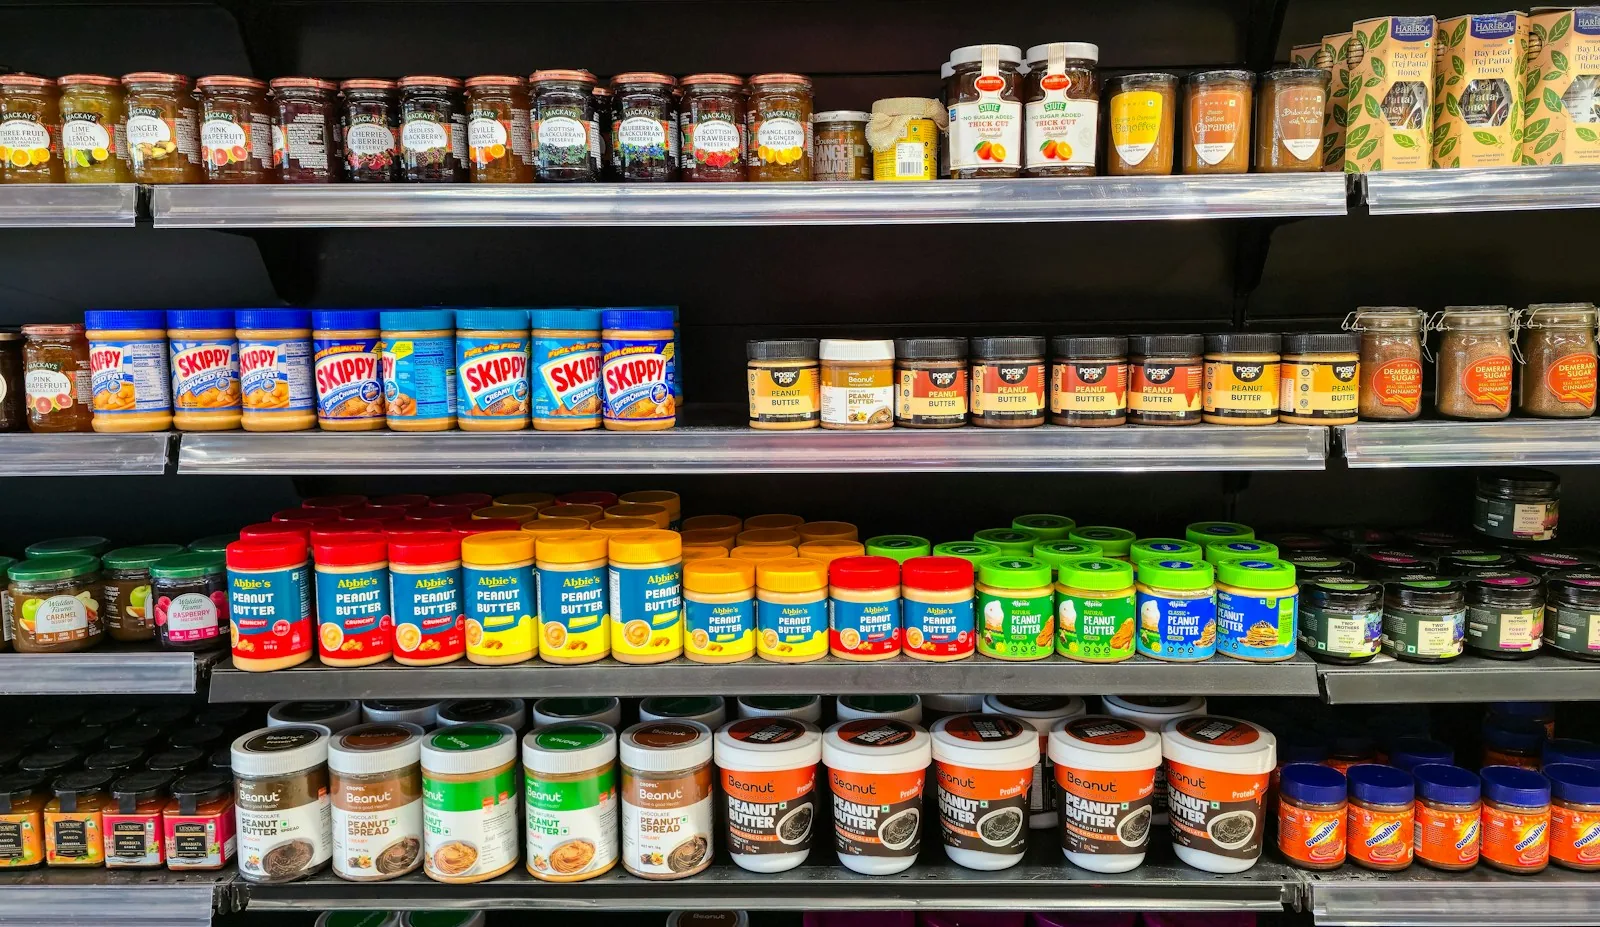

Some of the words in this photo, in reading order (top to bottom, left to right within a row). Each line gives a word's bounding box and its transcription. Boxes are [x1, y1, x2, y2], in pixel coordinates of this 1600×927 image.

[1394, 52, 1408, 60] Bay
[1410, 51, 1428, 59] Leaf
[1474, 49, 1489, 58] Bay
[1492, 48, 1512, 56] Leaf
[1391, 60, 1406, 68] (Tej
[1407, 60, 1429, 68] Patta)
[1471, 58, 1487, 66] (Tej
[1488, 57, 1513, 65] Patta)
[1397, 68, 1421, 77] Honey
[1478, 67, 1504, 75] Honey
[3, 112, 36, 121] MACKAYS
[66, 112, 96, 122] MACKAYS
[205, 112, 233, 121] MACKAYS
[406, 111, 435, 121] MACKAYS
[545, 109, 576, 118] MACKAYS
[625, 108, 655, 118] MACKAYS
[702, 111, 732, 121] MACKAYS
[766, 110, 796, 119] MACKAYS
[352, 116, 384, 125] MACKAYS
[129, 124, 158, 132] GINGER
[1195, 122, 1235, 133] Caramel
[620, 345, 657, 356] CRUNCHY
[28, 361, 58, 371] MACKAYS
[178, 350, 229, 378] SKIPPY
[1559, 363, 1595, 372] DEMERARA
[214, 370, 233, 380] FAT
[261, 371, 280, 380] FAT
[316, 357, 375, 394] SKIPPY
[466, 355, 526, 393] SKIPPY
[1384, 368, 1420, 376] DEMERARA
[1475, 366, 1511, 374] DEMERARA
[1567, 369, 1592, 377] SUGAR
[107, 372, 124, 382] FAT
[606, 358, 665, 395] SKIPPY
[778, 377, 793, 385] POP
[848, 375, 874, 384] Beanut
[1006, 373, 1020, 381] POP
[1150, 373, 1166, 381] POP
[1240, 372, 1256, 380] POP
[1391, 374, 1416, 382] SUGAR
[936, 378, 951, 386] POP
[1562, 383, 1594, 391] CINNAMON
[771, 389, 801, 397] PEANUT
[997, 386, 1029, 394] PEANUT
[1075, 385, 1107, 393] PEANUT
[1142, 385, 1176, 394] PEANUT
[1231, 384, 1263, 392] PEANUT
[1478, 385, 1508, 394] CINNAMON
[484, 386, 510, 405] CREAMY
[848, 392, 875, 400] PEANUT
[928, 390, 957, 398] PEANUT
[997, 395, 1027, 403] BUTTER
[1075, 394, 1105, 402] BUTTER
[1142, 395, 1173, 403] BUTTER
[1231, 393, 1262, 401] BUTTER
[771, 398, 800, 407] BUTTER
[337, 577, 378, 590] Abbie's
[415, 577, 454, 590] Abbie's
[478, 576, 518, 588] Abbie's
[562, 576, 601, 588] Abbie's
[646, 571, 680, 586] Abbie's
[233, 578, 271, 591] Abbie's
[335, 589, 380, 604] PEANUT
[413, 589, 457, 604] PEANUT
[476, 589, 521, 601] PEANUT
[561, 588, 602, 602] PEANUT
[645, 583, 681, 600] PEANUT
[232, 592, 274, 604] PEANUT
[335, 602, 382, 616] BUTTER
[413, 601, 457, 616] BUTTER
[476, 601, 521, 613] BUTTER
[560, 600, 603, 614] BUTTER
[644, 596, 682, 612] BUTTER
[172, 609, 211, 619] RASPBERRY
[232, 604, 275, 616] BUTTER
[712, 606, 739, 615] Abbie's
[781, 607, 808, 616] Abbie's
[863, 606, 889, 615] Abbie's
[926, 607, 953, 615] Abbie's
[46, 612, 77, 620] CARAMEL
[422, 616, 452, 626] CRUNCHY
[708, 614, 742, 625] PEANUT
[778, 615, 811, 626] PEANUT
[859, 613, 892, 624] PEANUT
[922, 615, 957, 625] PEANUT
[1011, 614, 1042, 625] PEANUT
[1083, 615, 1116, 626] PEANUT
[1167, 615, 1200, 627] PEANUT
[344, 617, 375, 627] CRUNCHY
[708, 623, 742, 634] BUTTER
[778, 625, 812, 634] BUTTER
[859, 623, 892, 633] BUTTER
[922, 624, 957, 635] BUTTER
[1011, 624, 1041, 636] BUTTER
[1083, 625, 1116, 637] BUTTER
[1167, 625, 1200, 637] BUTTER
[728, 774, 775, 793] Beanut
[833, 772, 877, 796] Beanut
[1067, 771, 1118, 793] Beanut
[239, 788, 281, 803] Beanut
[527, 785, 564, 803] Beanut
[639, 788, 684, 800] Beanut
[899, 784, 920, 800] Protein
[999, 785, 1021, 798] Protein
[1231, 789, 1256, 800] Protein
[346, 792, 393, 804] Beanut
[1065, 790, 1121, 817] PEANUT
[728, 795, 780, 817] PEANUT
[833, 793, 881, 819] PEANUT
[529, 813, 560, 828] PEANUT
[640, 816, 681, 827] PEANUT
[728, 807, 776, 830] BUTTER
[833, 808, 877, 832] BUTTER
[1066, 803, 1117, 830] BUTTER
[241, 818, 278, 828] PEANUT
[347, 819, 389, 829] PEANUT
[529, 821, 559, 836] BUTTER
[640, 823, 681, 834] SPREAD
[242, 826, 278, 837] BUTTER
[348, 826, 390, 837] SPREAD
[1305, 819, 1339, 847] ovomaltine
[1365, 821, 1401, 848] ovomaltine
[1515, 822, 1548, 851] ovomaltine
